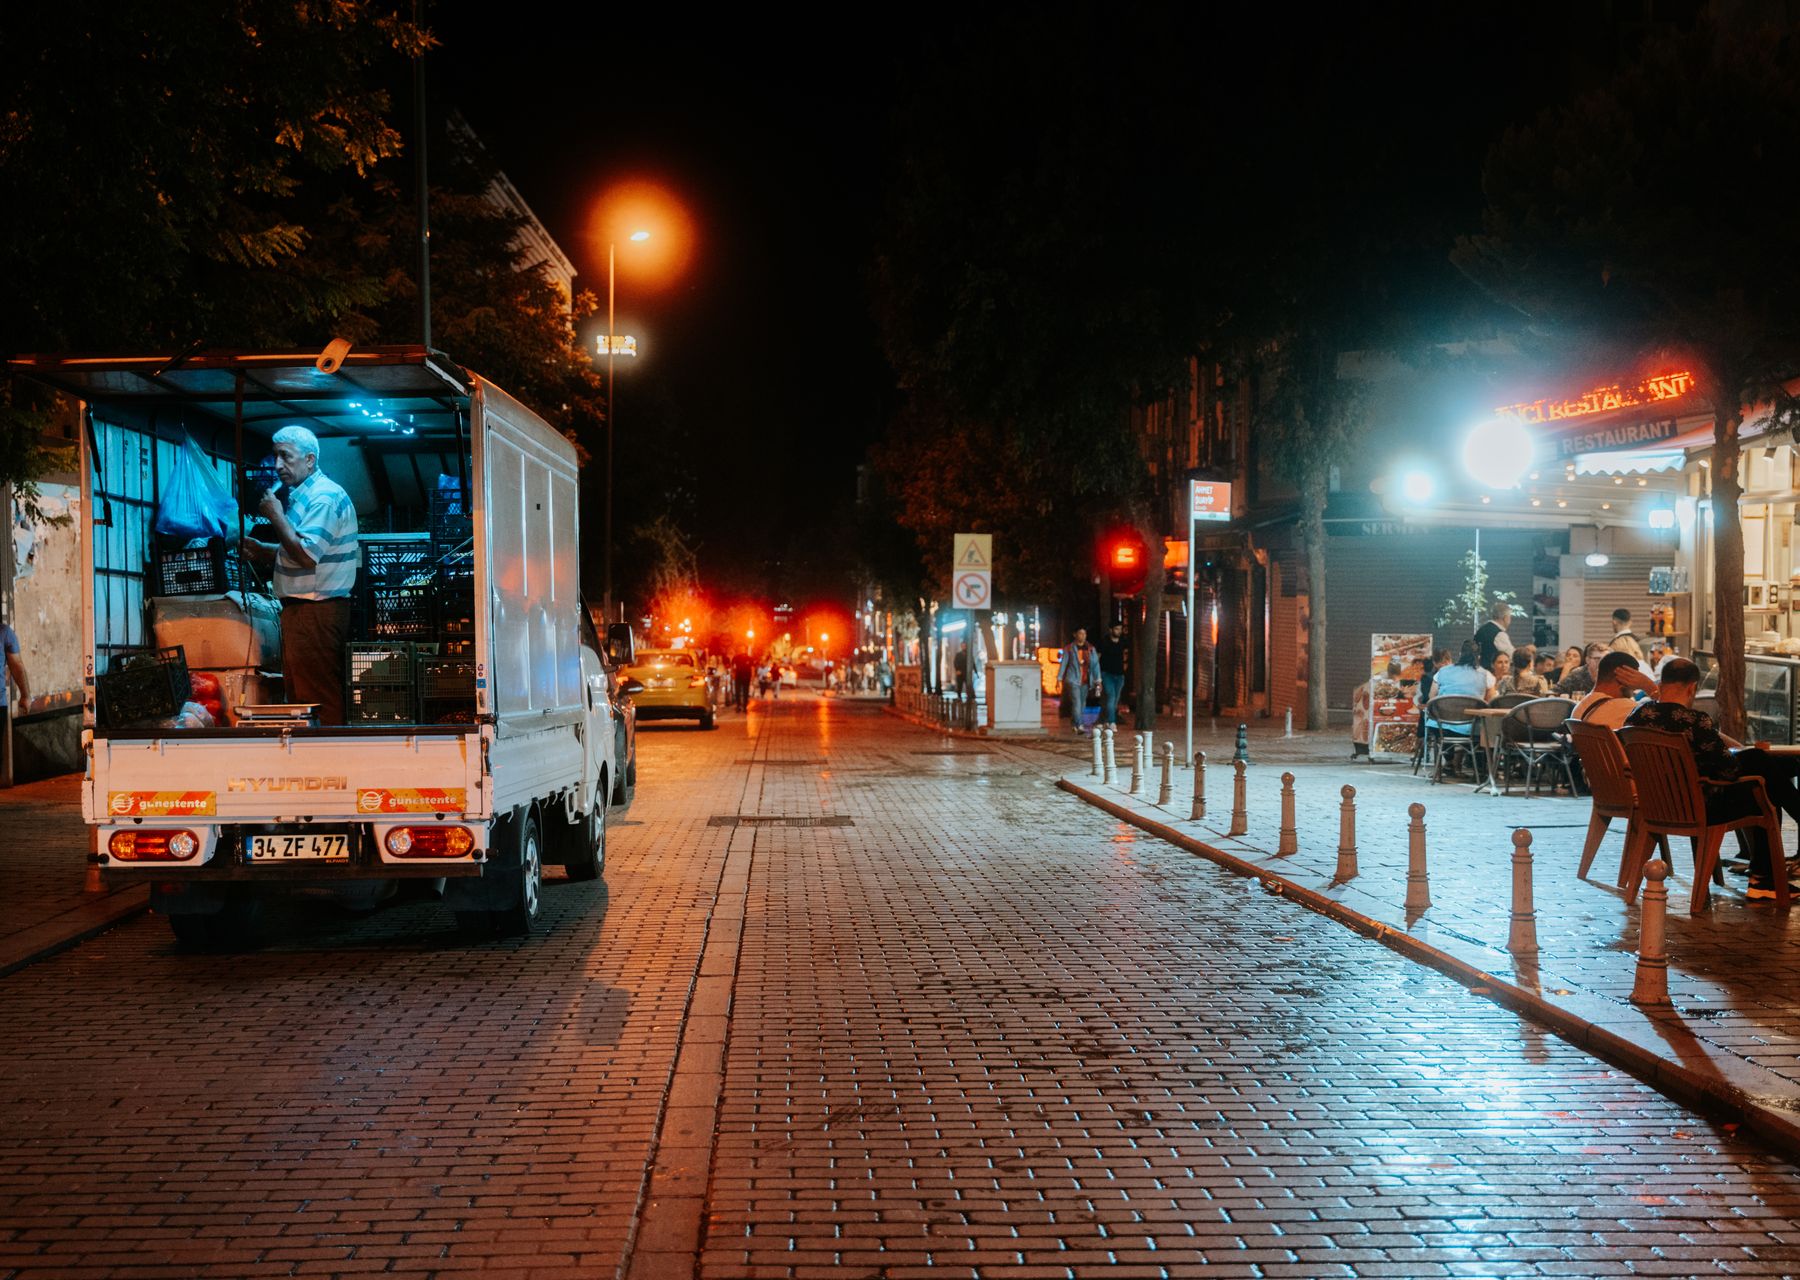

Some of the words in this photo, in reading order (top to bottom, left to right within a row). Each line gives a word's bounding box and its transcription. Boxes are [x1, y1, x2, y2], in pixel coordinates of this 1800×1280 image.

[1562, 420, 1673, 455] RESTAURANT
[227, 776, 348, 792] HYUNDAI
[254, 838, 277, 858] 34
[283, 837, 306, 857] ZF
[311, 836, 346, 857] 477
